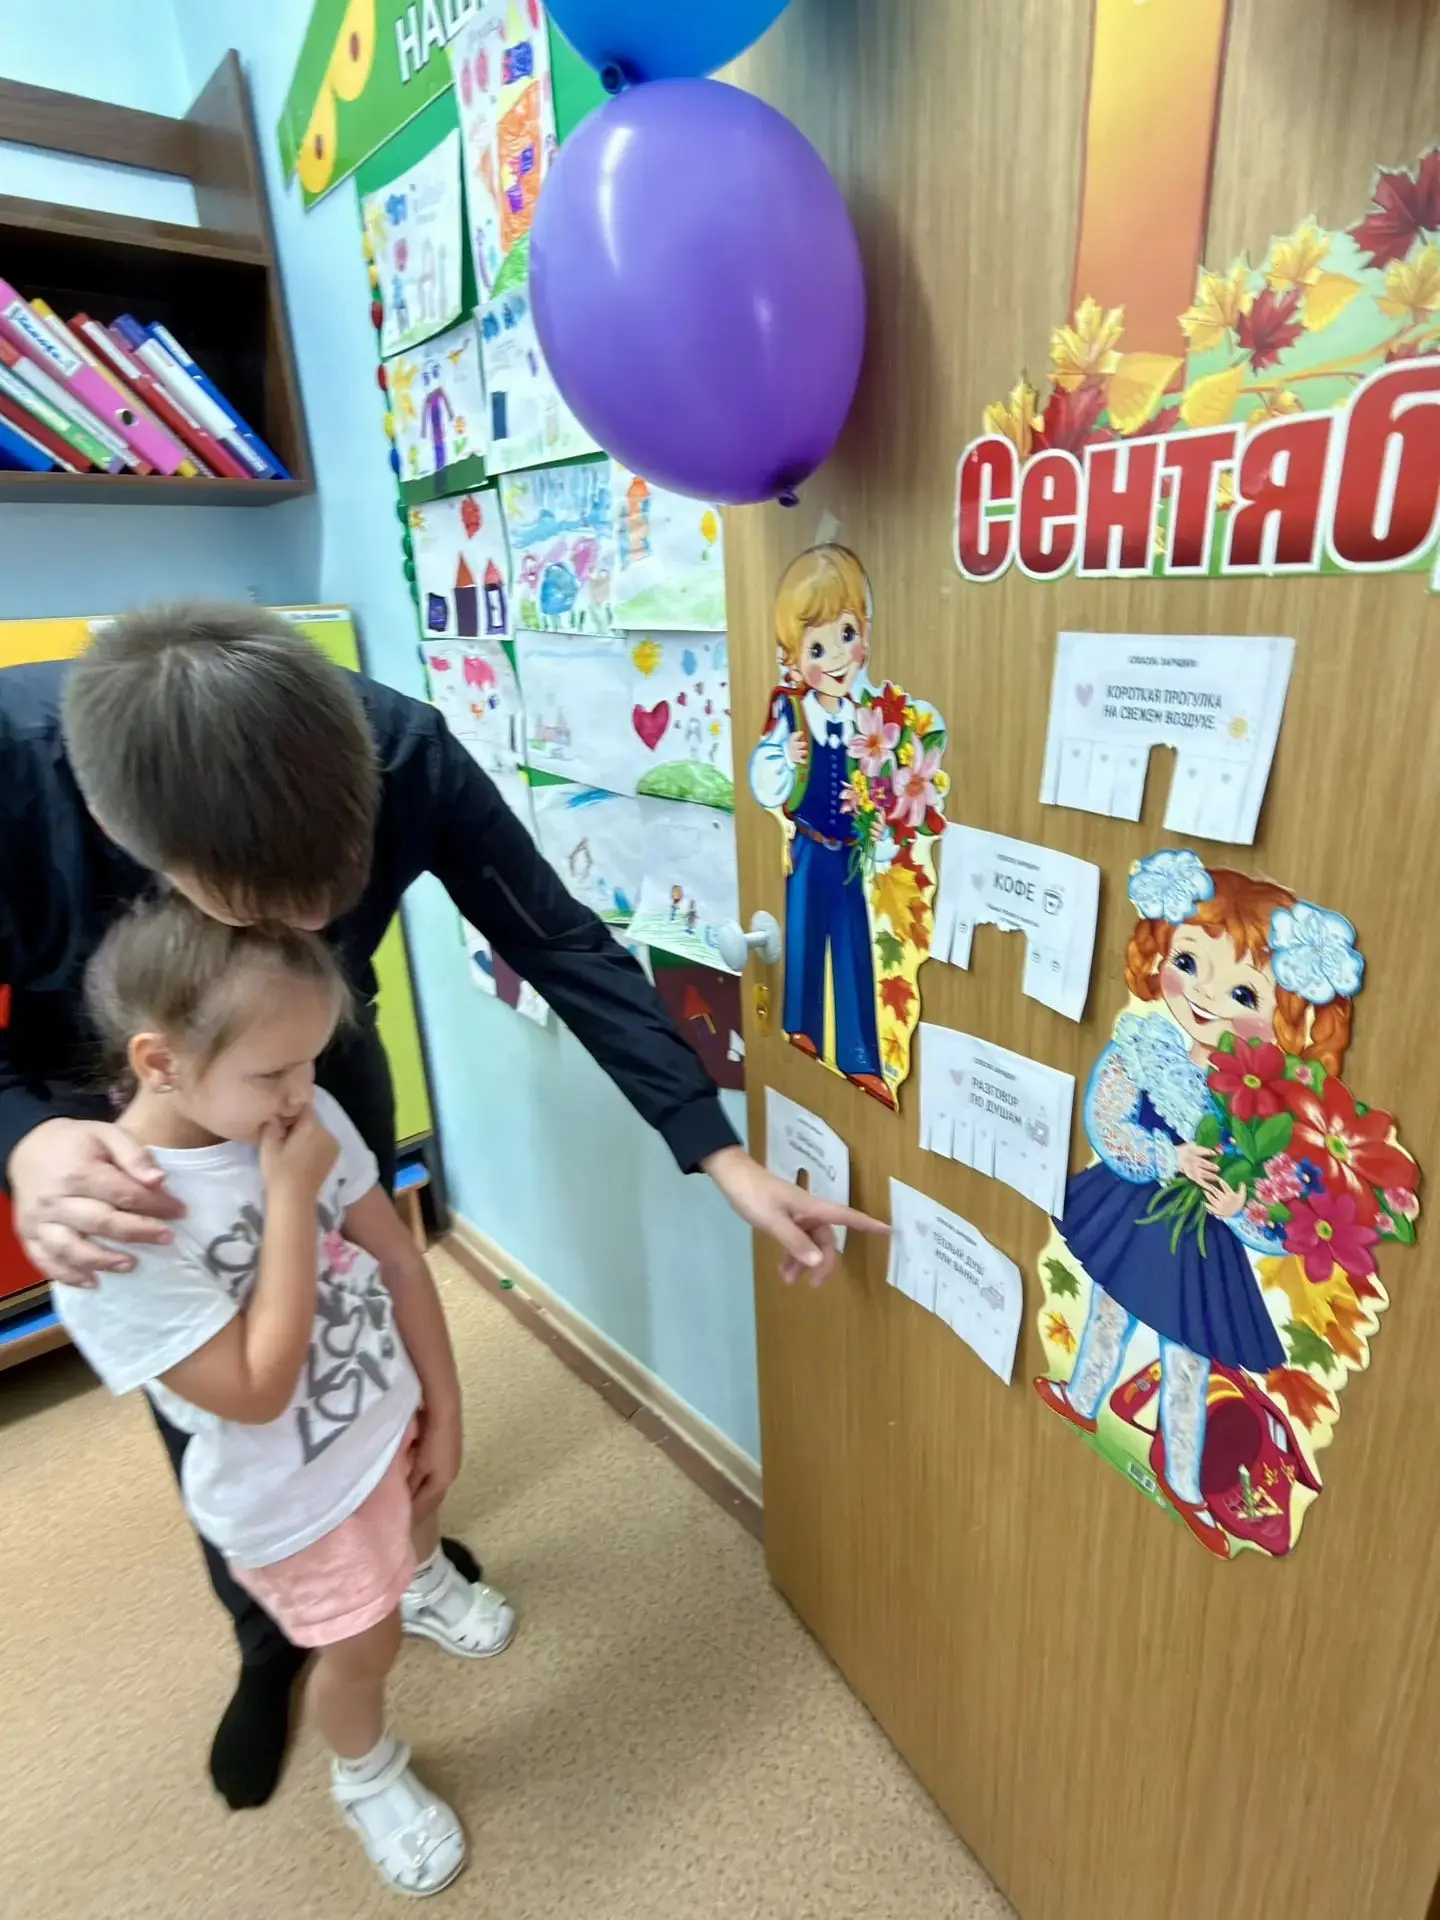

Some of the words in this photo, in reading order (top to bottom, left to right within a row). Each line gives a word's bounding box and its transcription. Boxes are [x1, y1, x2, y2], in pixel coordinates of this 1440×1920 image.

[956, 358, 1440, 580] Сентяб
[1106, 684, 1162, 704] КОРОТКАЯ
[1164, 688, 1222, 709] ПРОГУЛКА
[1104, 704, 1118, 719] НА
[1120, 705, 1162, 724] СВЕЖЕМ
[993, 871, 1036, 902] КОФЕ
[972, 1076, 1020, 1108] РАЗГОВОР
[970, 1092, 985, 1108] ПО
[985, 1099, 1023, 1126] ДУШАМ
